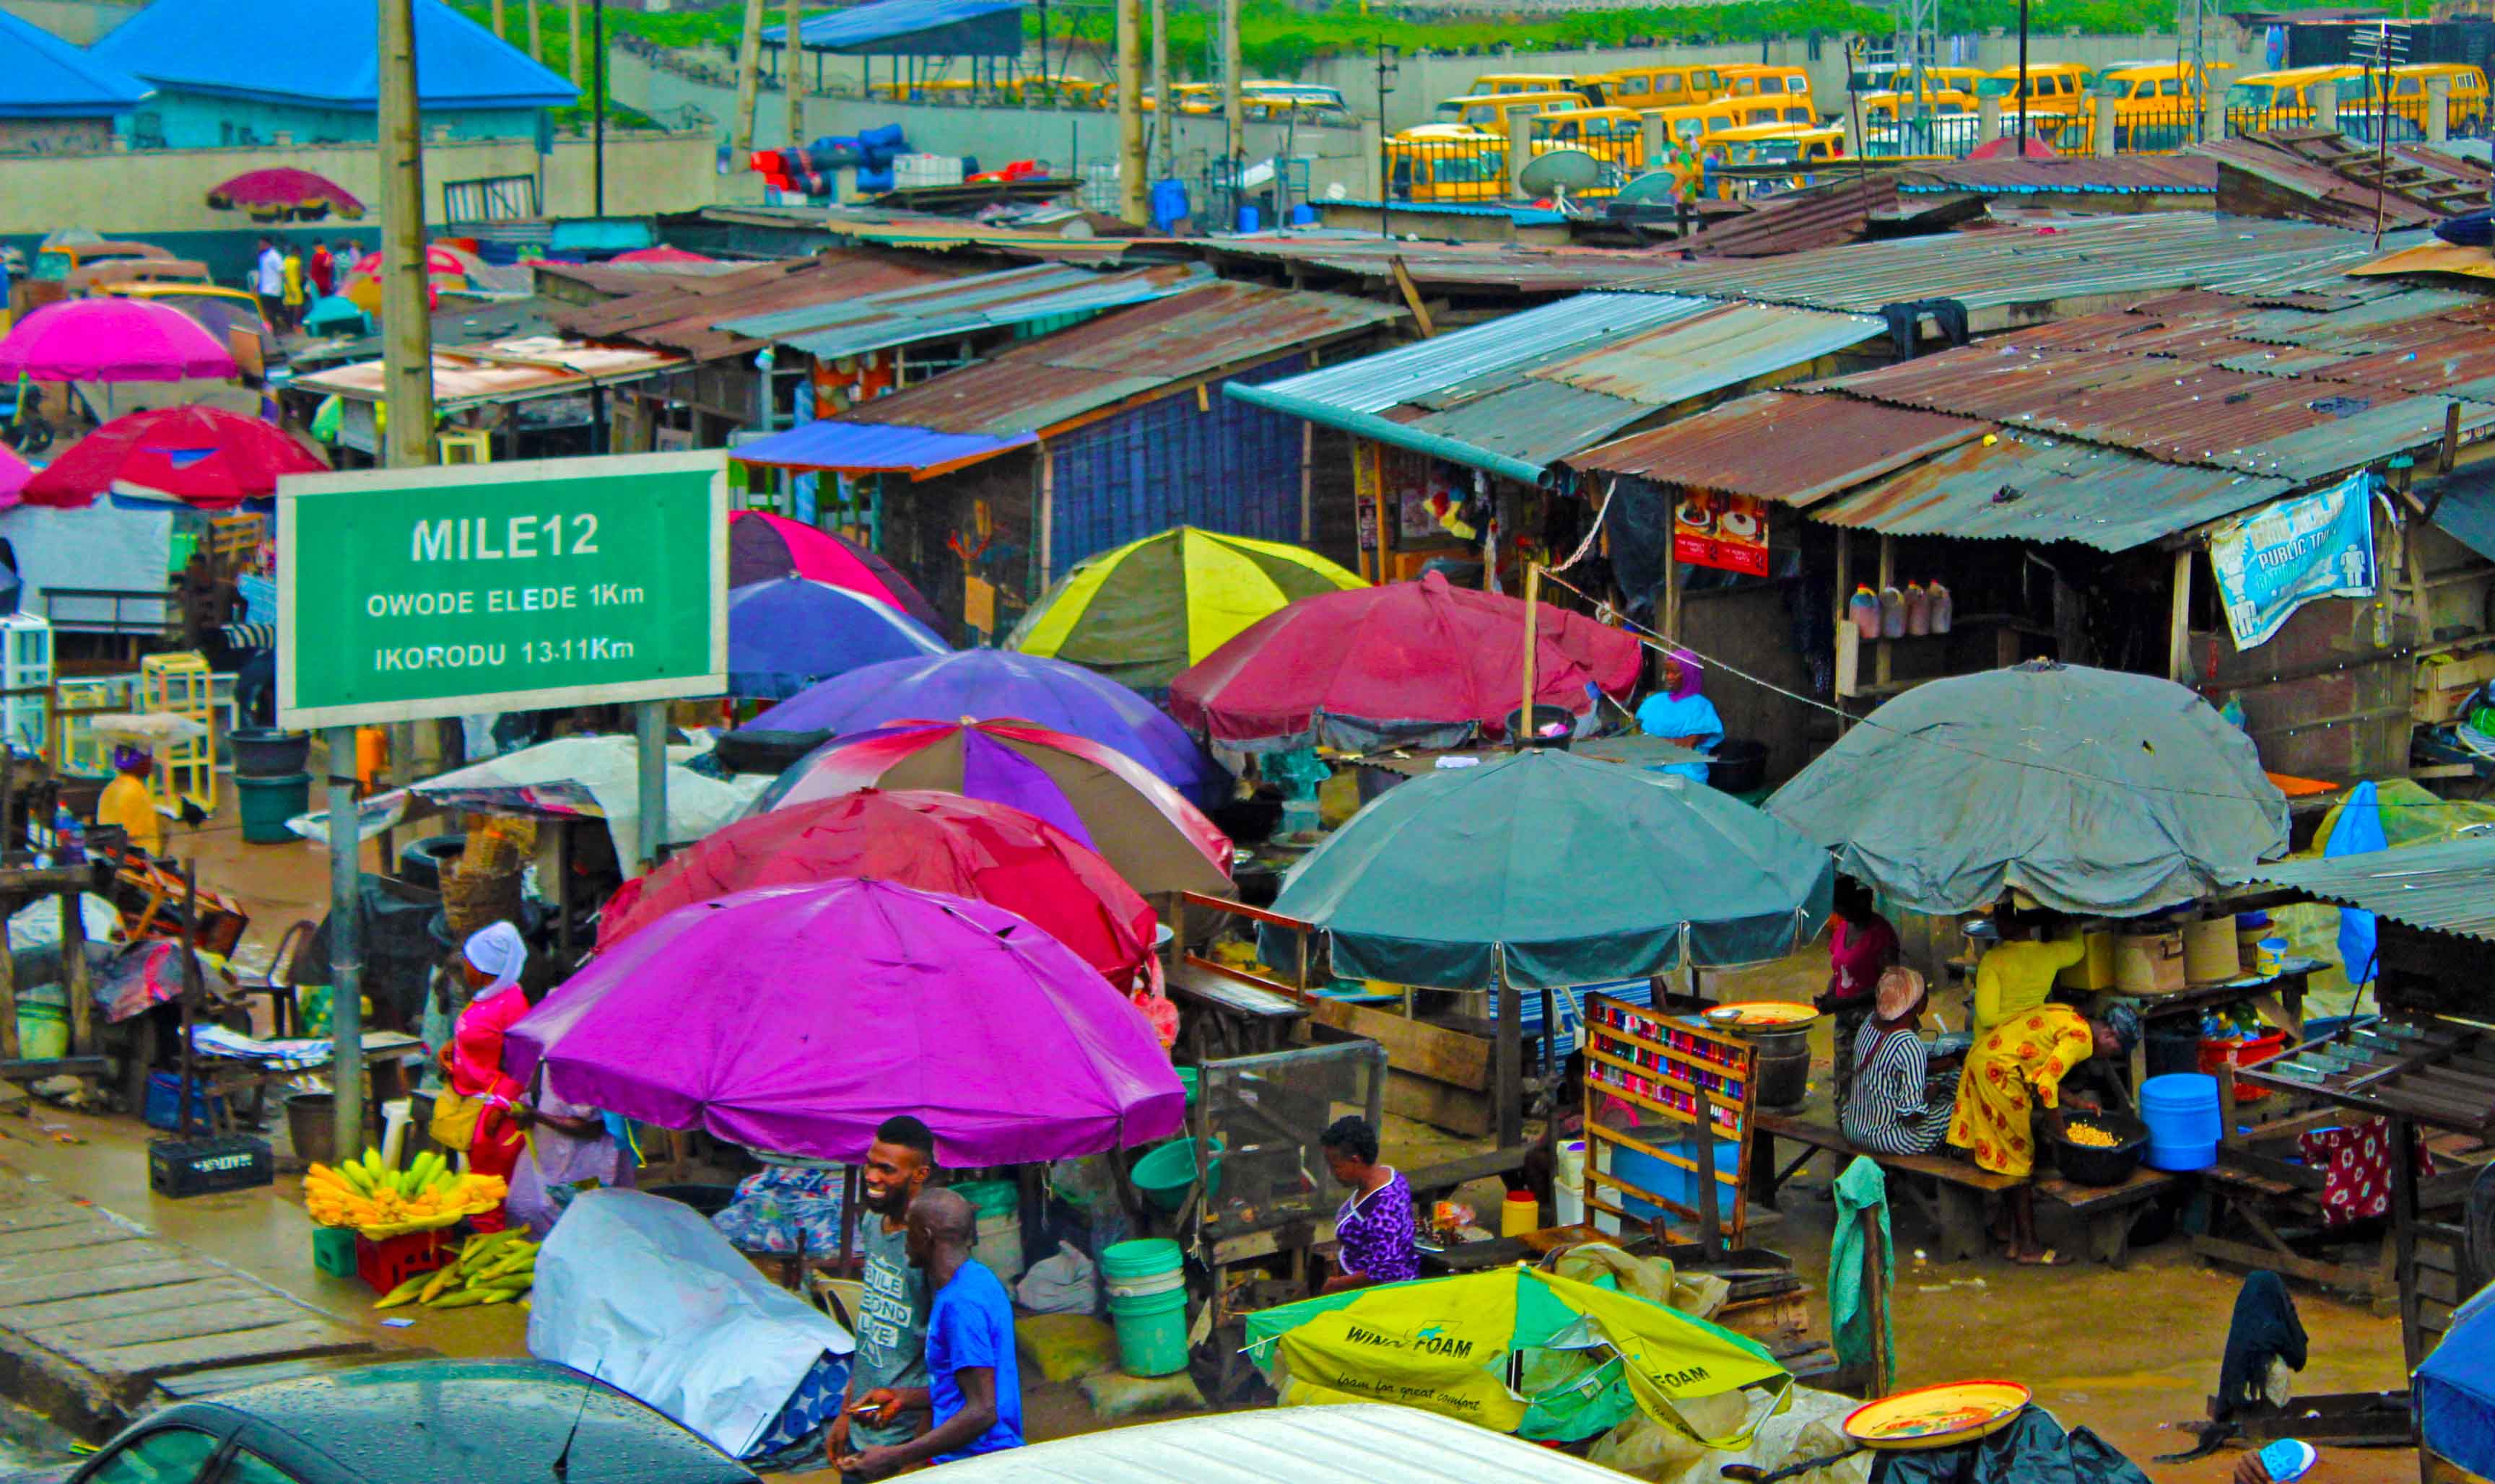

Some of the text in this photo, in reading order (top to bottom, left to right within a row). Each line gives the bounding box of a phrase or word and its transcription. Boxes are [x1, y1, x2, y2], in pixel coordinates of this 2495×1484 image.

[411, 513, 599, 562] MILE12
[2257, 538, 2307, 571] PUBLIC
[367, 582, 645, 618] OWODE ELEDE 1Km
[374, 643, 506, 671] IKORODU
[1413, 1335, 1473, 1359] FOAM
[1399, 1387, 1435, 1400] great
